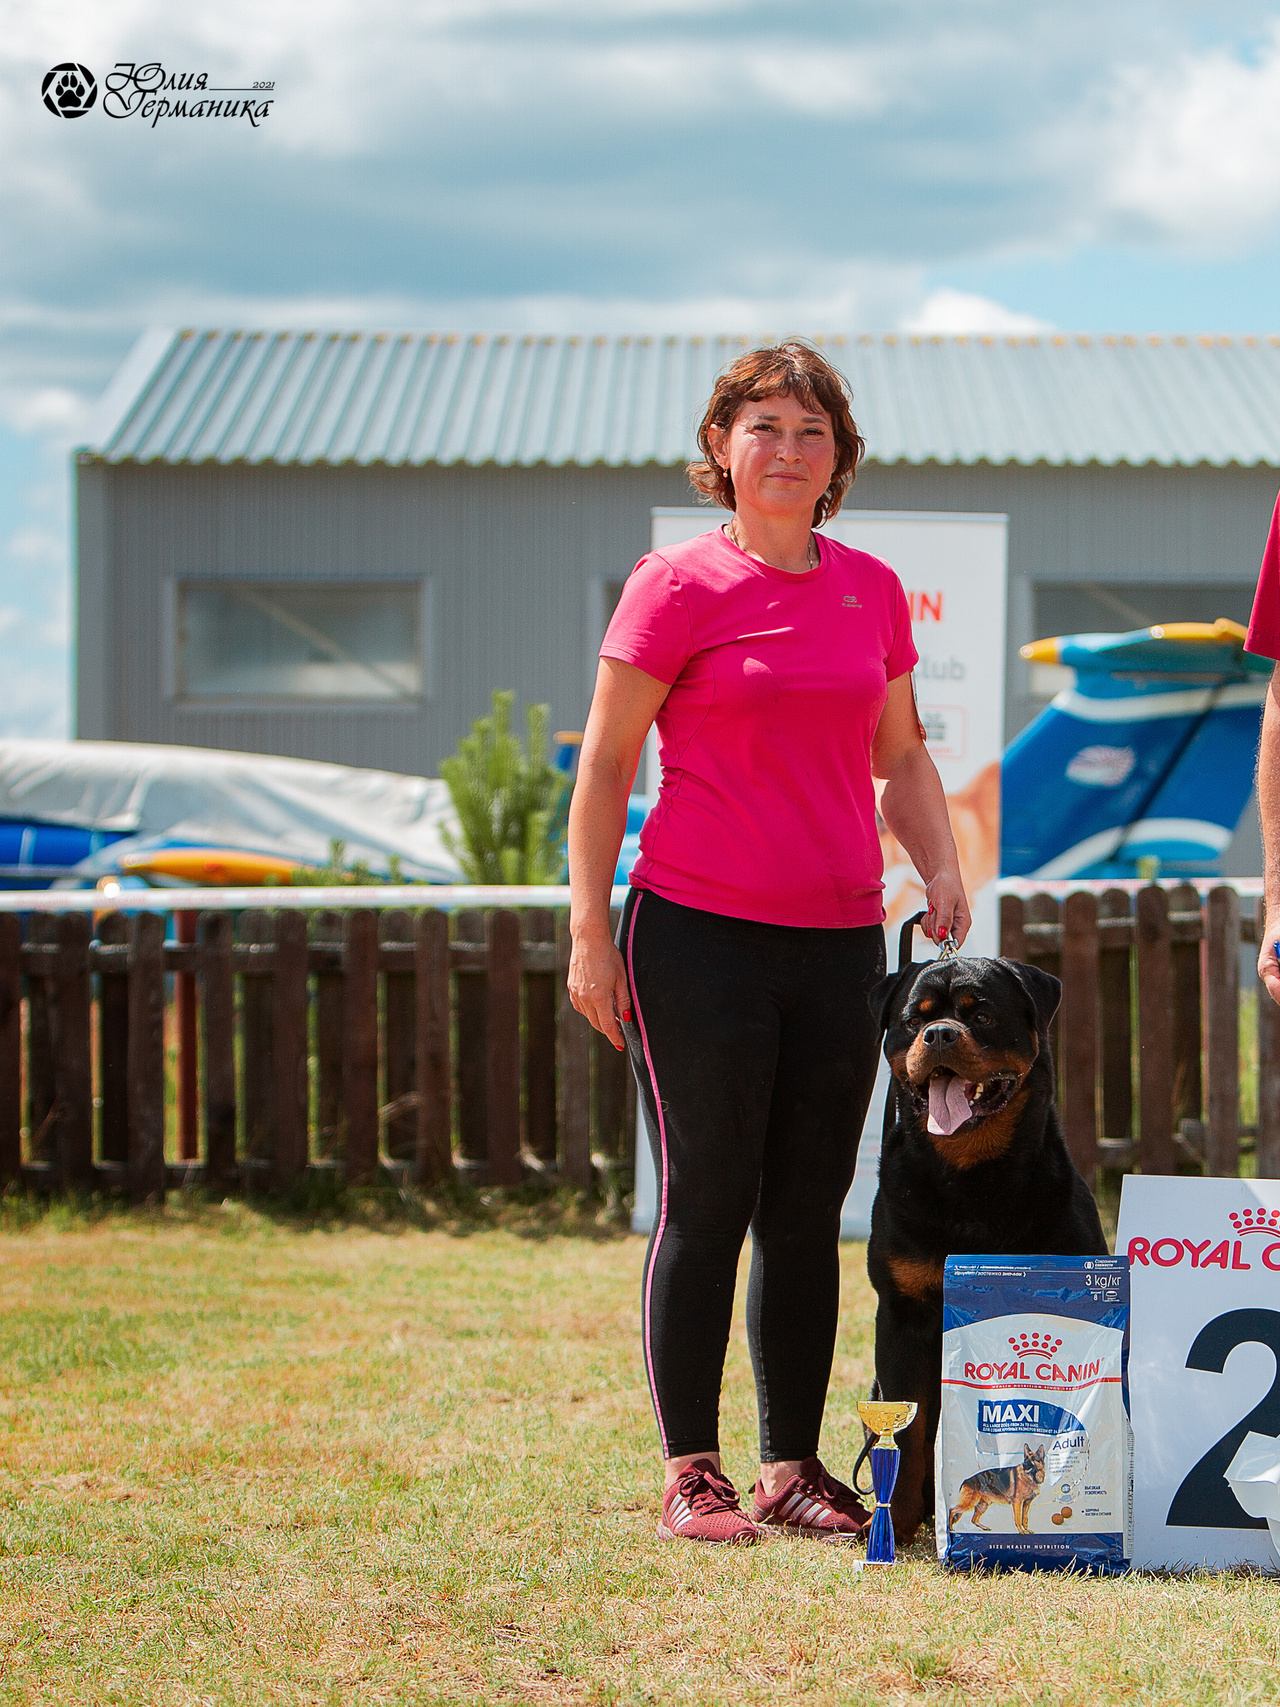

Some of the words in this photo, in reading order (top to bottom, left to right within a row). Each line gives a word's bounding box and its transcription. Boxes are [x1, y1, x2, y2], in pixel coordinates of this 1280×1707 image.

[1127, 1236, 1251, 1271] ROYAL
[1085, 1274, 1092, 1286] 3
[964, 1362, 1030, 1380] ROYAL
[1035, 1358, 1100, 1382] CANIN
[982, 1404, 1040, 1422] MAXI
[1052, 1436, 1084, 1450] Adult
